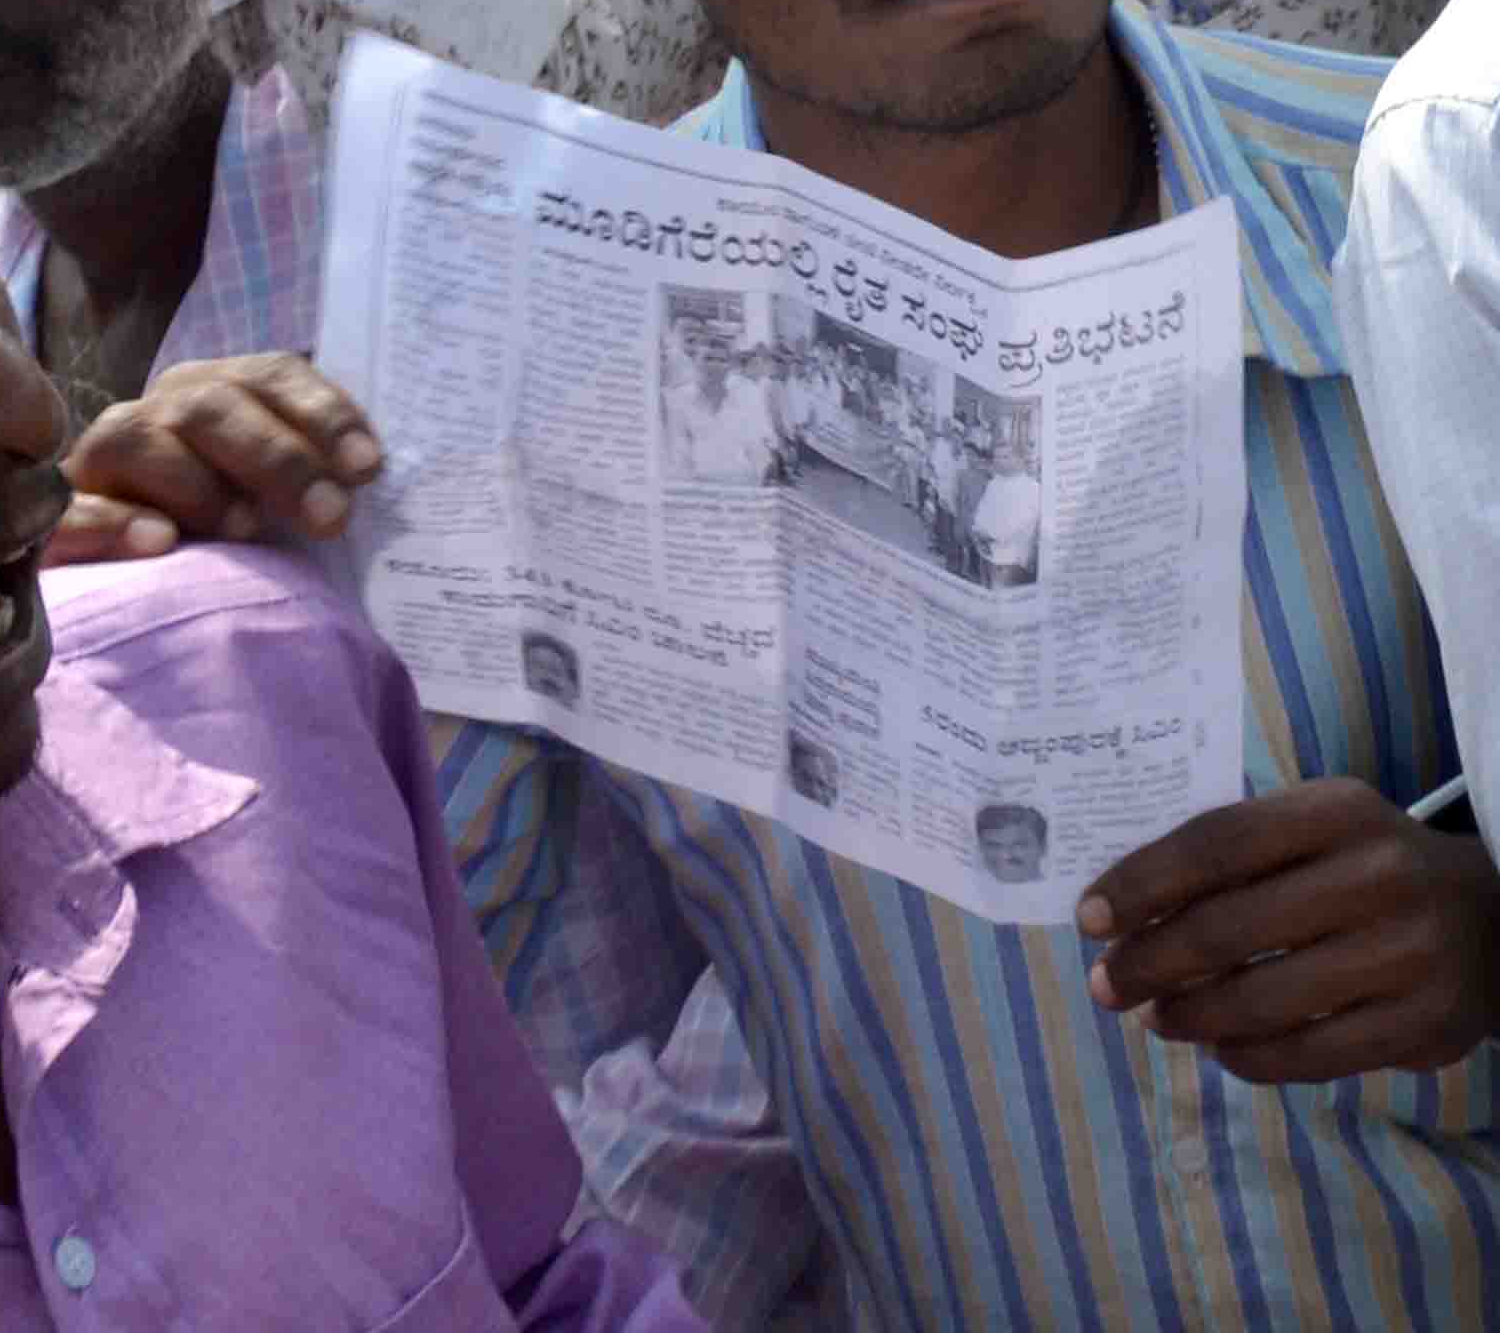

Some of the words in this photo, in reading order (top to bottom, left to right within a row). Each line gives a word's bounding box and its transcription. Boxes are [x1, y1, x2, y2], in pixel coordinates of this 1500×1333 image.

[534, 189, 830, 308] ಮೂಡಿಗೆರೆಯಲ್ಲಿ
[831, 258, 890, 321] ರೈತ
[901, 291, 986, 365] ಸಂಘ
[997, 290, 1189, 394] ಪ್ರತಿಭಟನೆ
